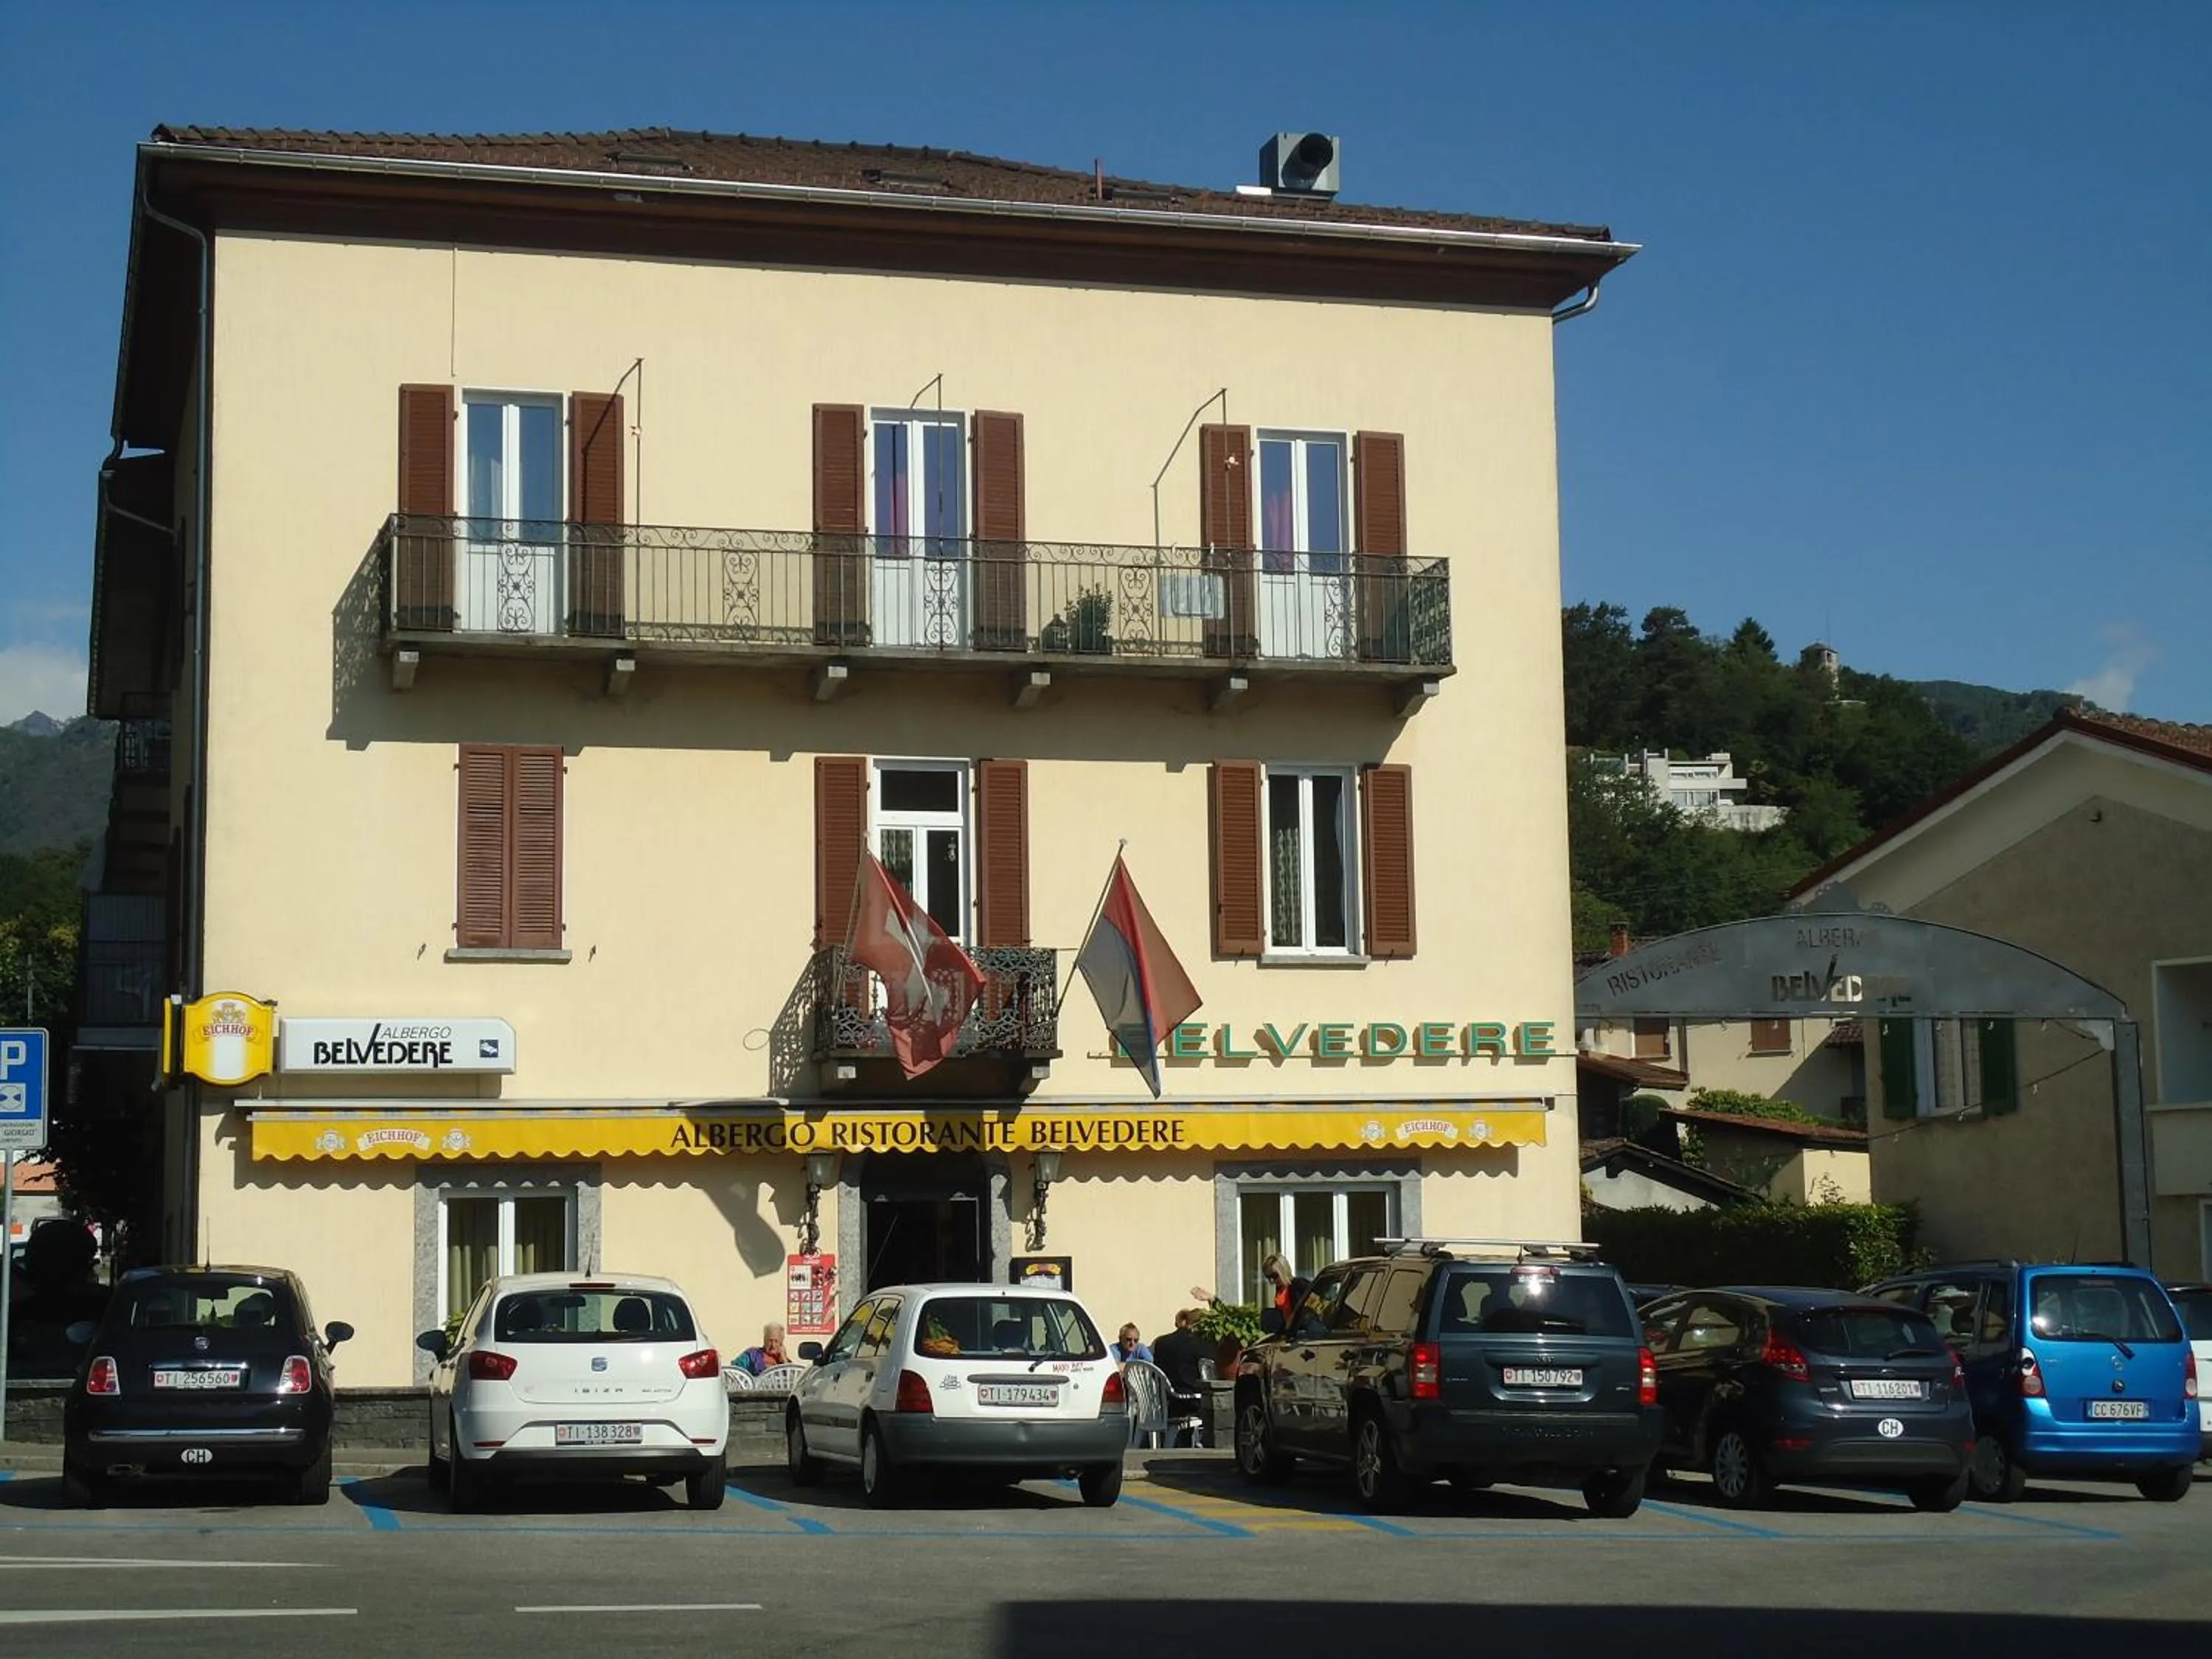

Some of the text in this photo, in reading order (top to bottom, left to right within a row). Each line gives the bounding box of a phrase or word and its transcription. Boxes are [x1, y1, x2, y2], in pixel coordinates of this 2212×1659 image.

[202, 1023, 254, 1035] EICHHOF
[380, 1026, 452, 1039] ALBERGO
[313, 1023, 453, 1068] BELVEDERE
[1, 1040, 27, 1079] P
[368, 1130, 422, 1143] EICHHOF
[671, 1119, 1186, 1148] ALBERGO RISTORANTE BELVEDERE
[1882, 1421, 1899, 1435] CH
[187, 1450, 206, 1464] CH
